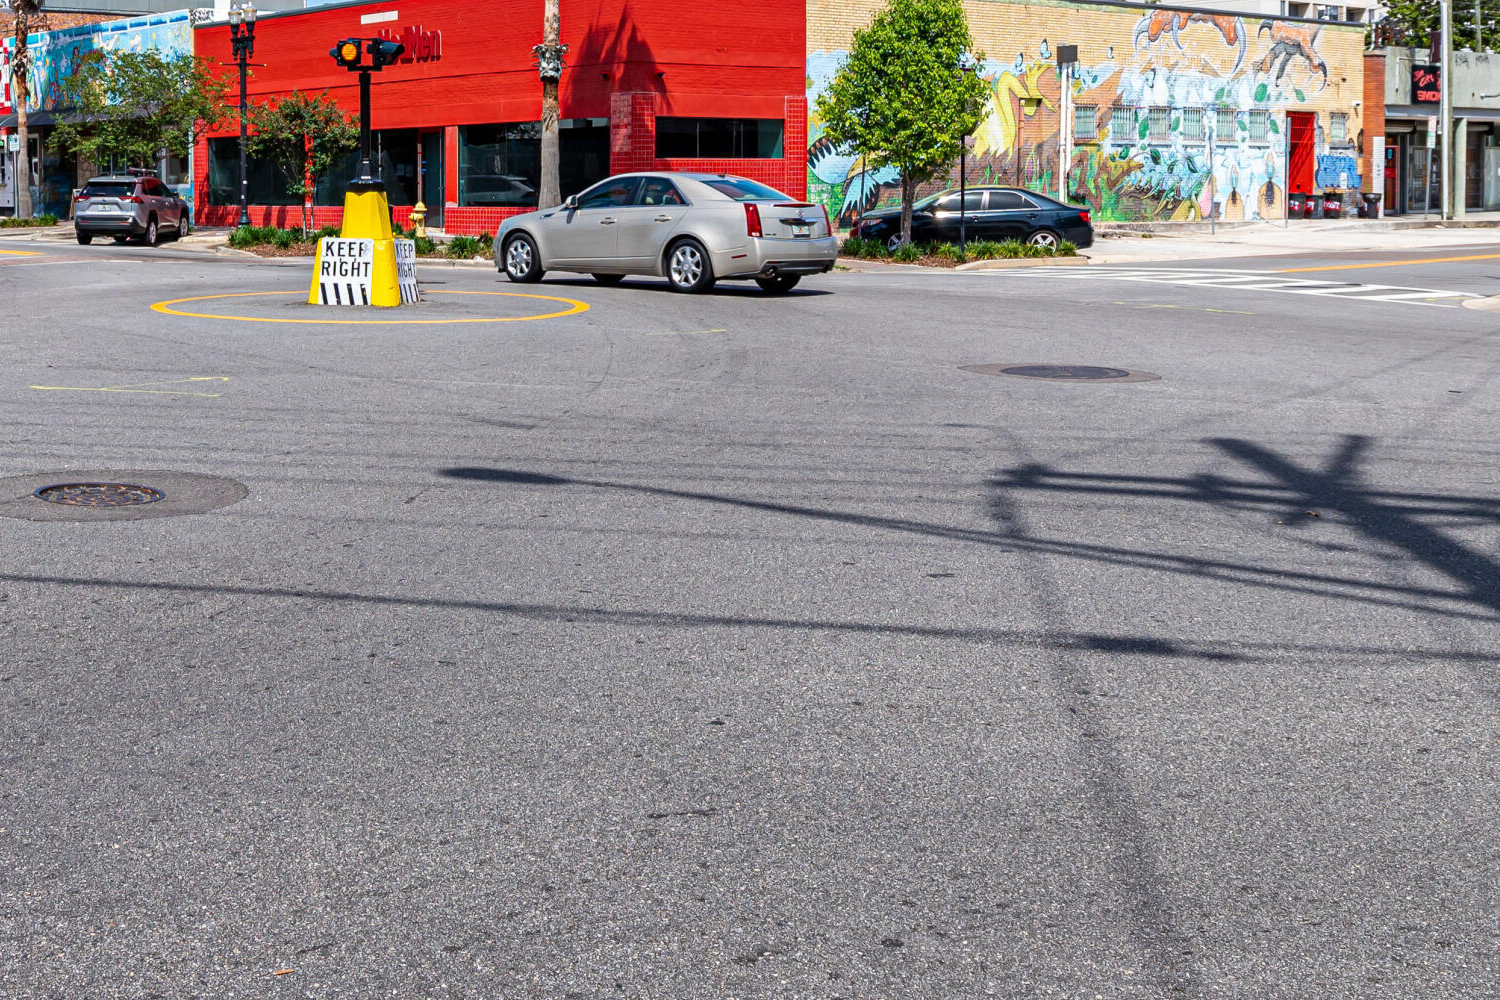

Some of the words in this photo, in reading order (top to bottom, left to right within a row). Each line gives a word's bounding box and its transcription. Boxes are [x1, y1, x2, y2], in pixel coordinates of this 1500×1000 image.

[325, 241, 368, 257] KEEP
[396, 243, 414, 259] KEEP
[321, 260, 371, 277] RIGHT
[397, 262, 417, 278] RIGHT
